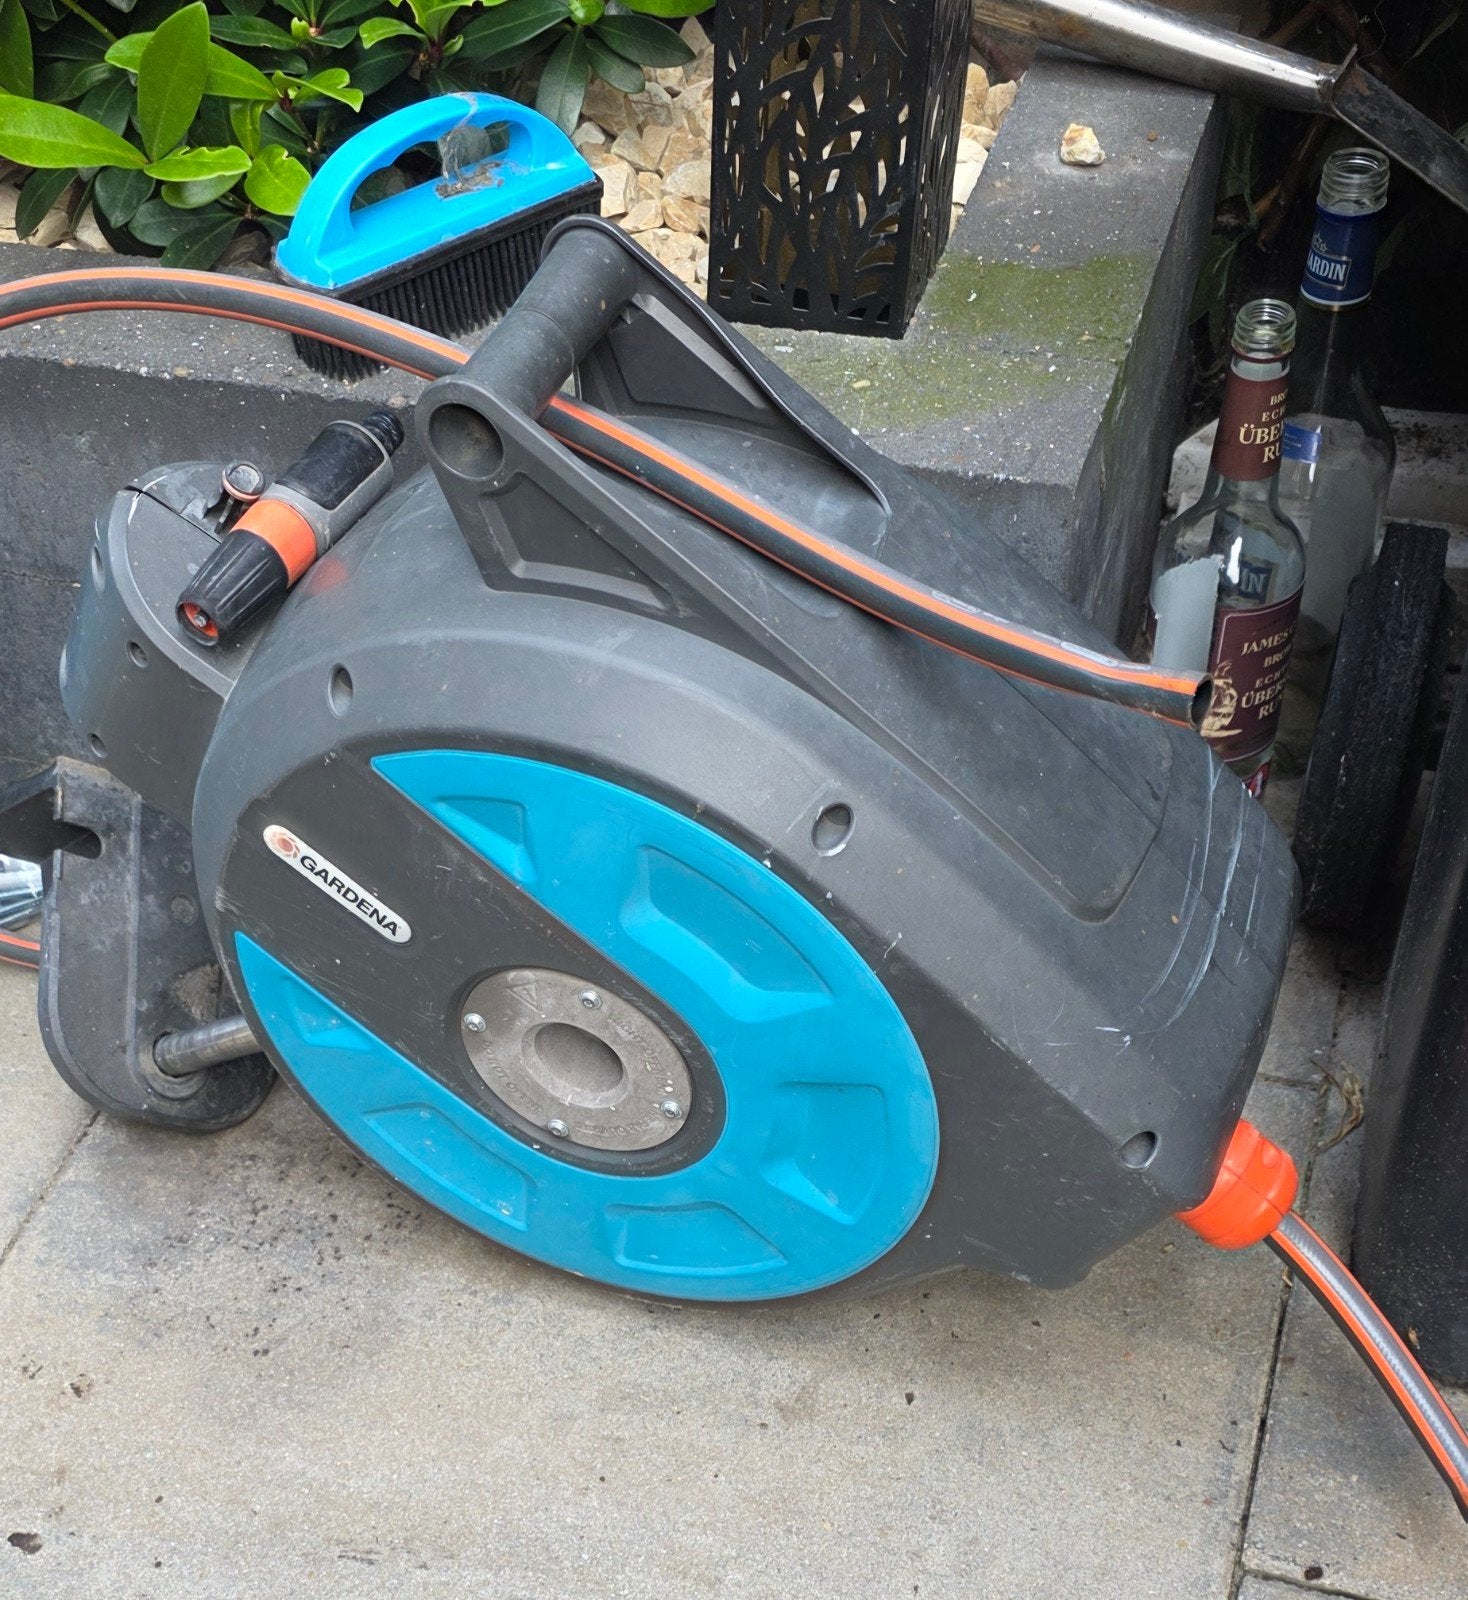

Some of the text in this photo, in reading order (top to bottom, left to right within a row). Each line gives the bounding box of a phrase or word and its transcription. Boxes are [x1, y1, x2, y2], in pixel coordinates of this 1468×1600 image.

[1306, 251, 1347, 282] ARDIN
[1239, 420, 1284, 445] ÜBE
[300, 855, 398, 937] GARDENA
